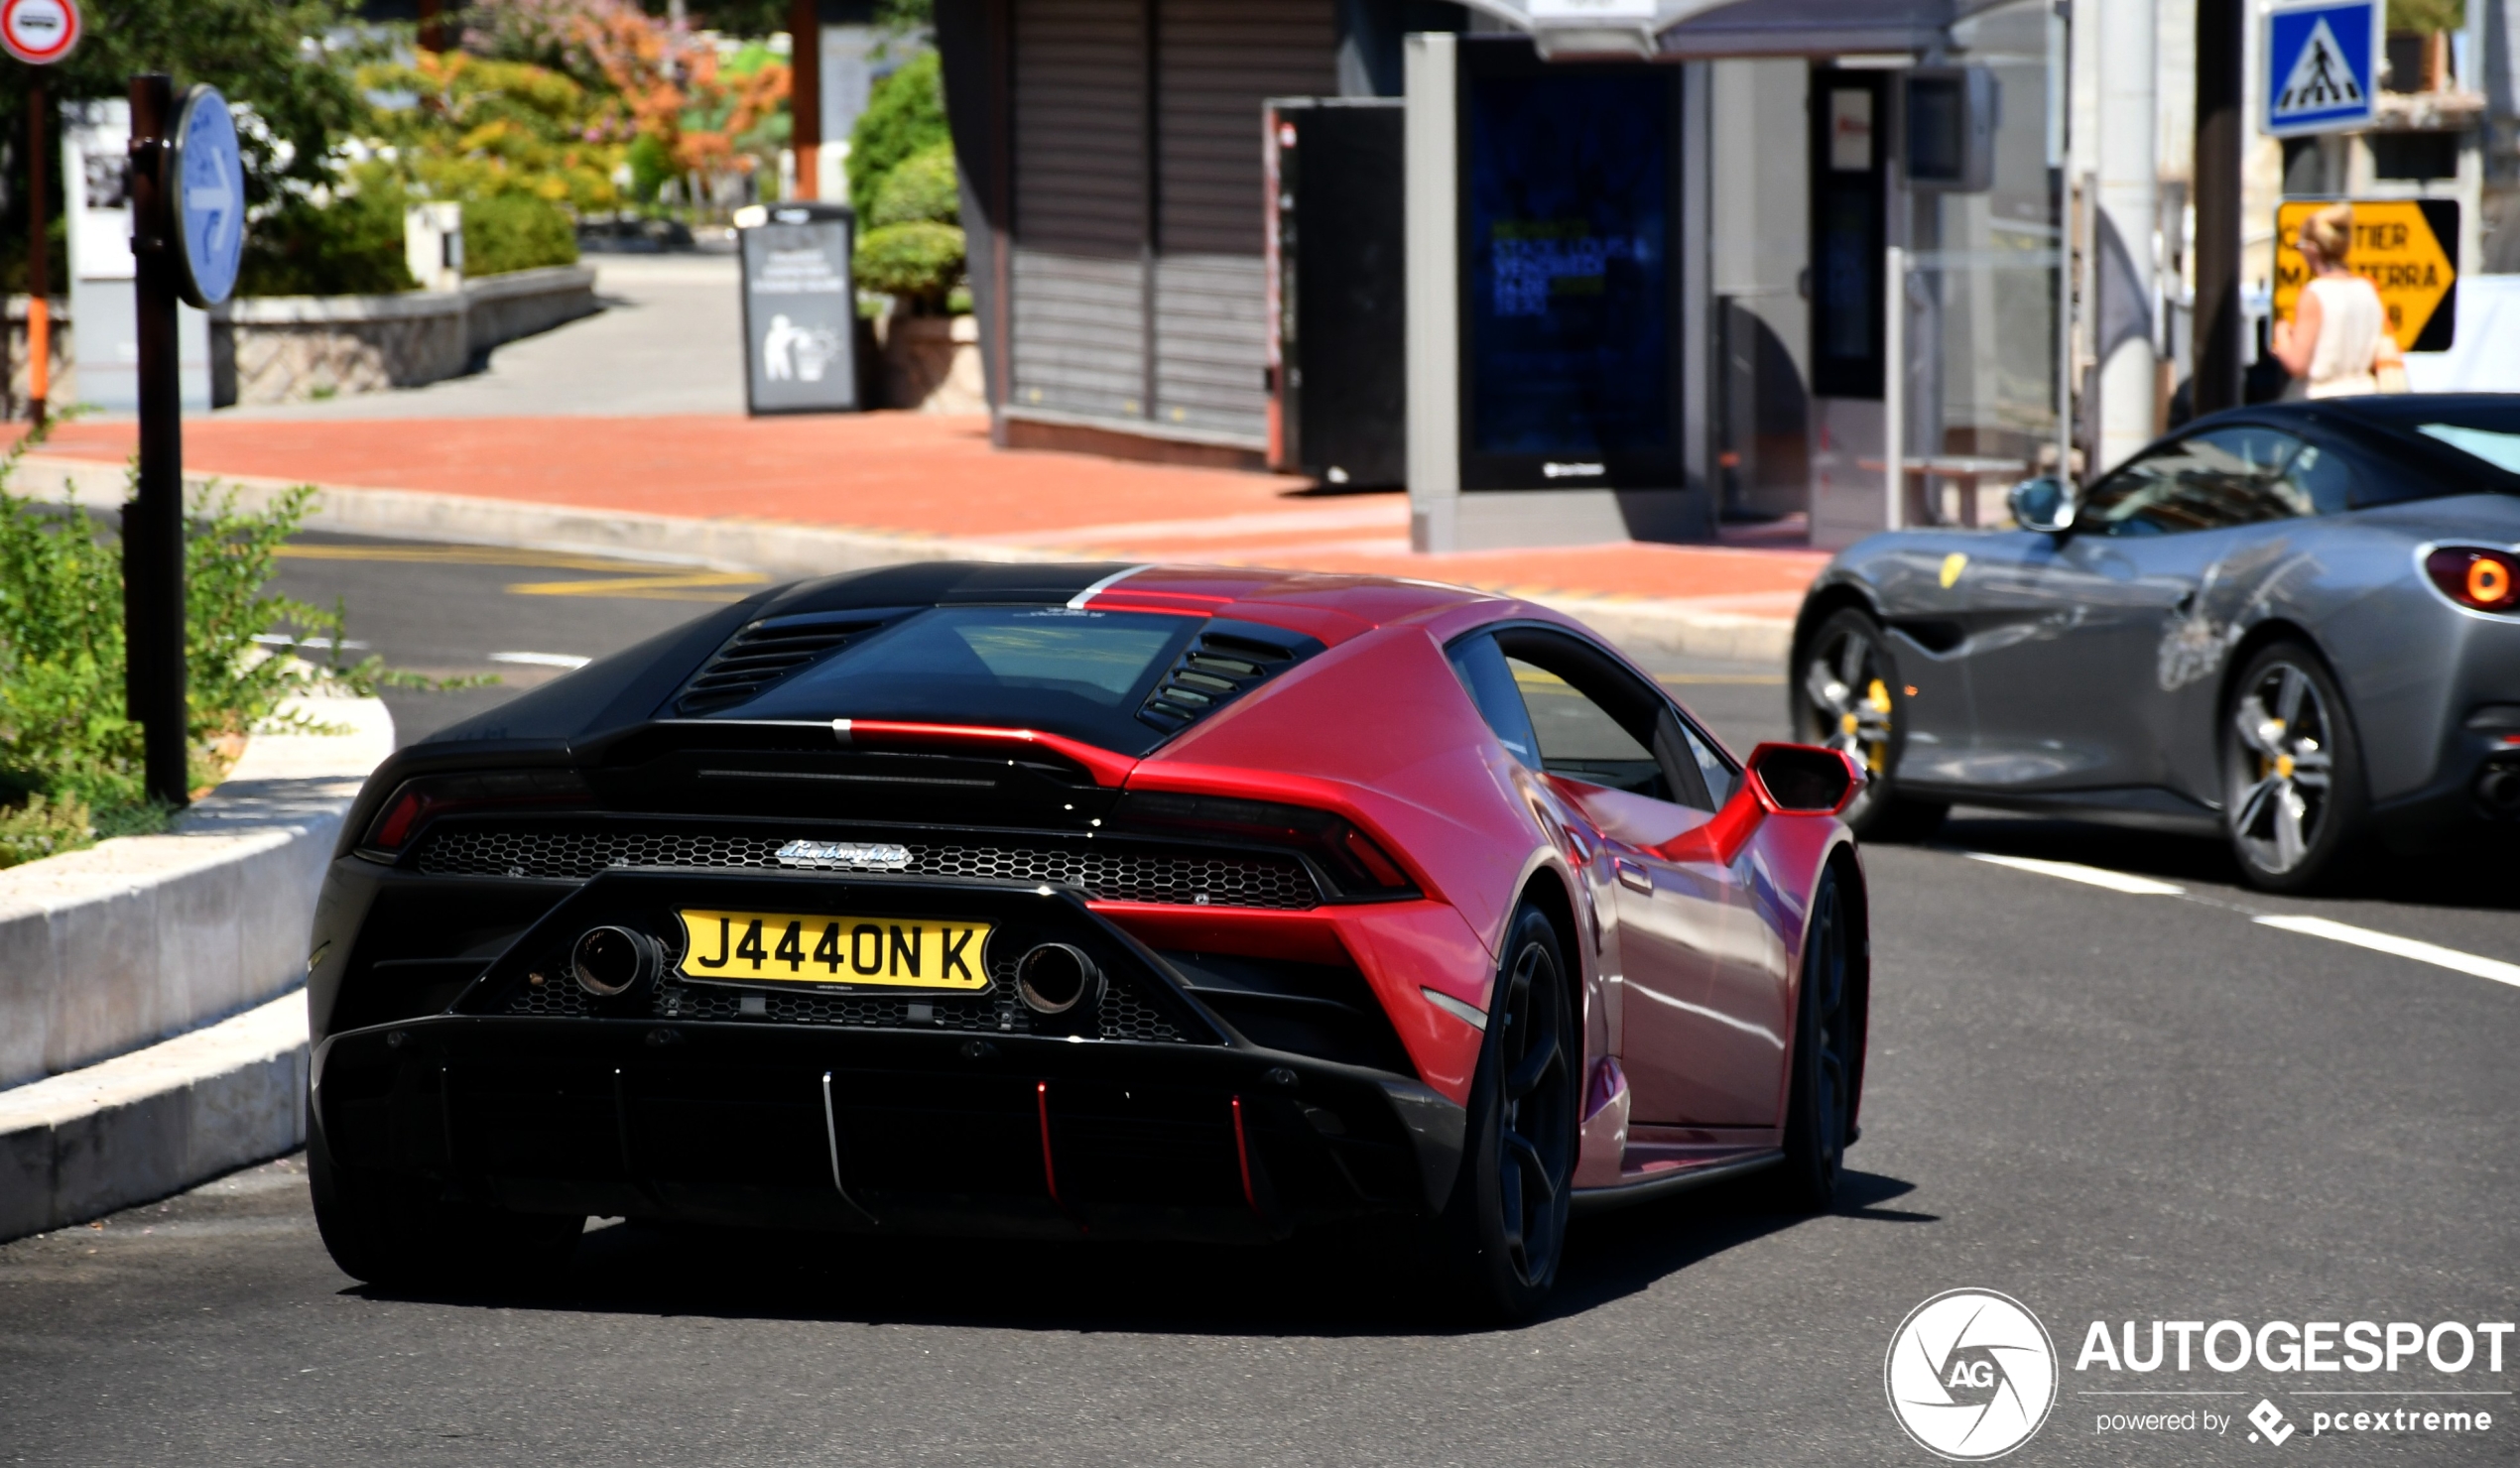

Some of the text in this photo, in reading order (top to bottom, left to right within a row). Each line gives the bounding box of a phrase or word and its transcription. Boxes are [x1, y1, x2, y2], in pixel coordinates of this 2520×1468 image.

[2283, 224, 2408, 248] CTIER
[774, 839, 907, 864] Lamborghini
[942, 927, 973, 981] K
